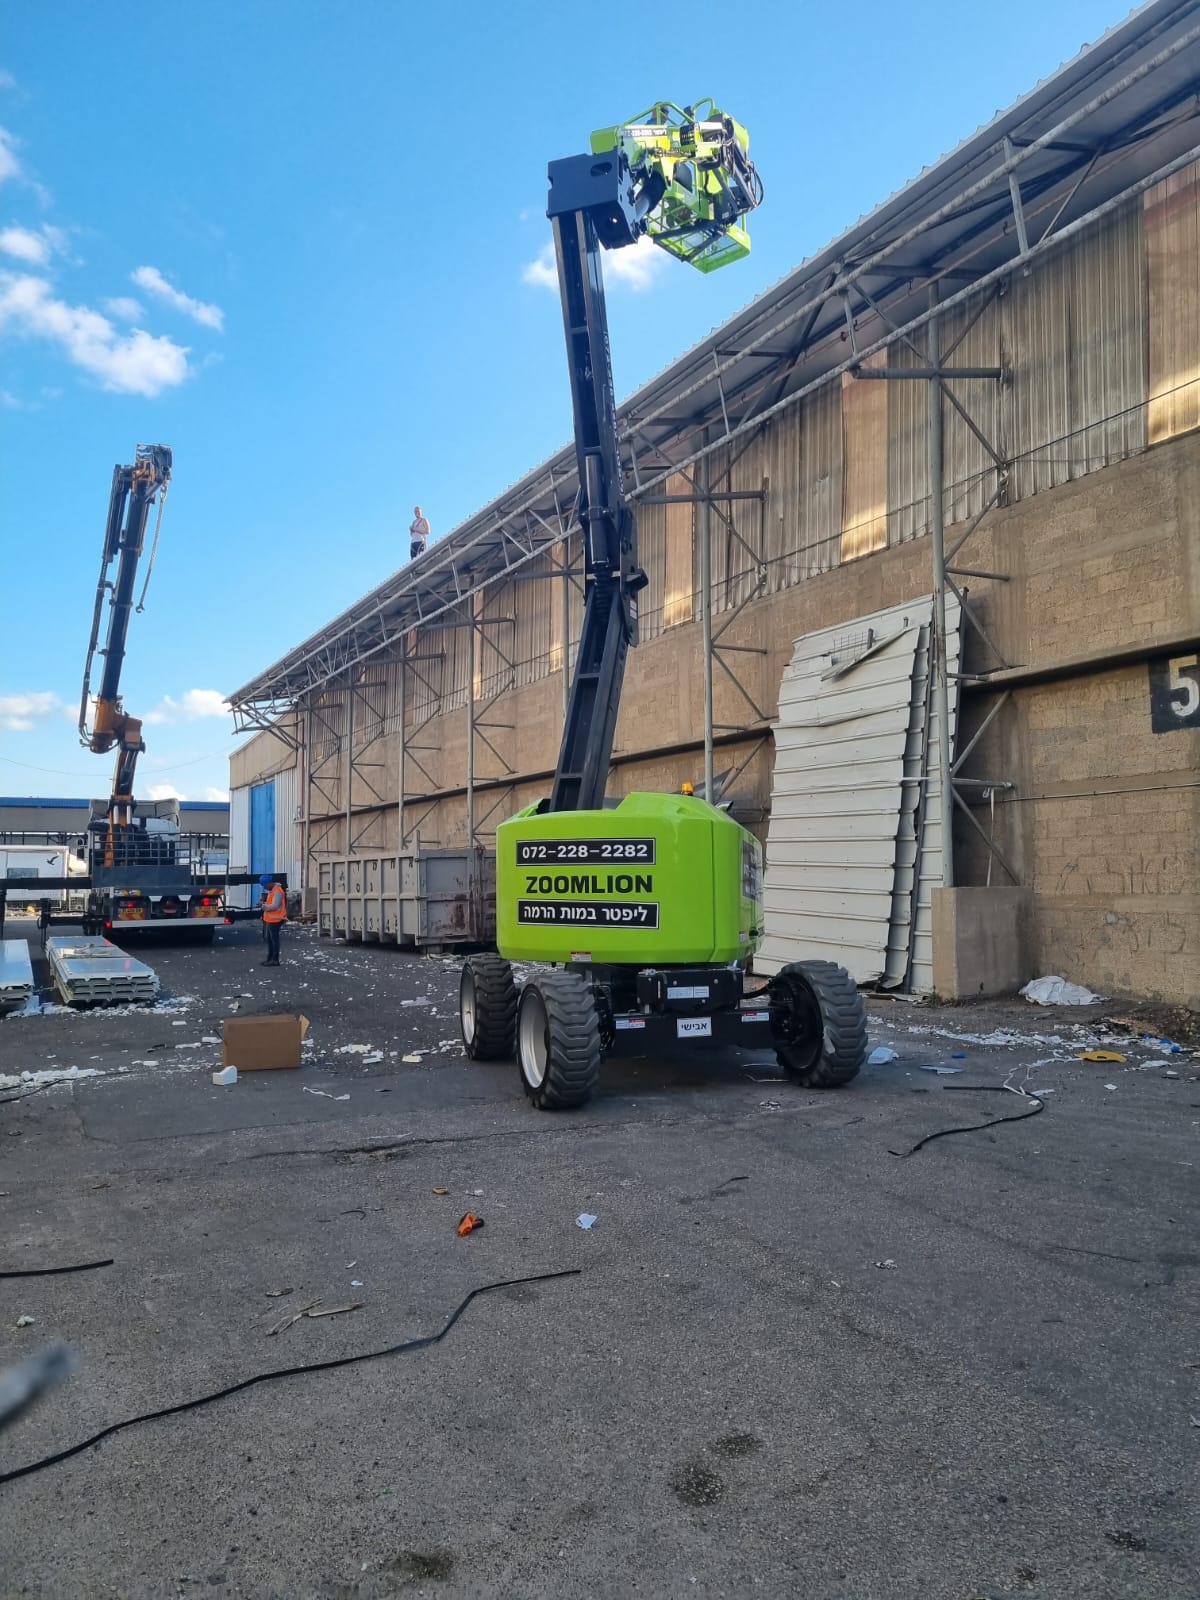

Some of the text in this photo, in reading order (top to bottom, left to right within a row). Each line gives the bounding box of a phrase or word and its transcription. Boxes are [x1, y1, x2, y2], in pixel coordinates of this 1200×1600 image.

[1169, 654, 1200, 717] 5
[522, 844, 648, 859] 072-228-2282
[525, 875, 653, 894] ZOOMLION
[524, 905, 648, 921] ליפטר במות הרמה
[681, 1022, 708, 1031] אבישי
